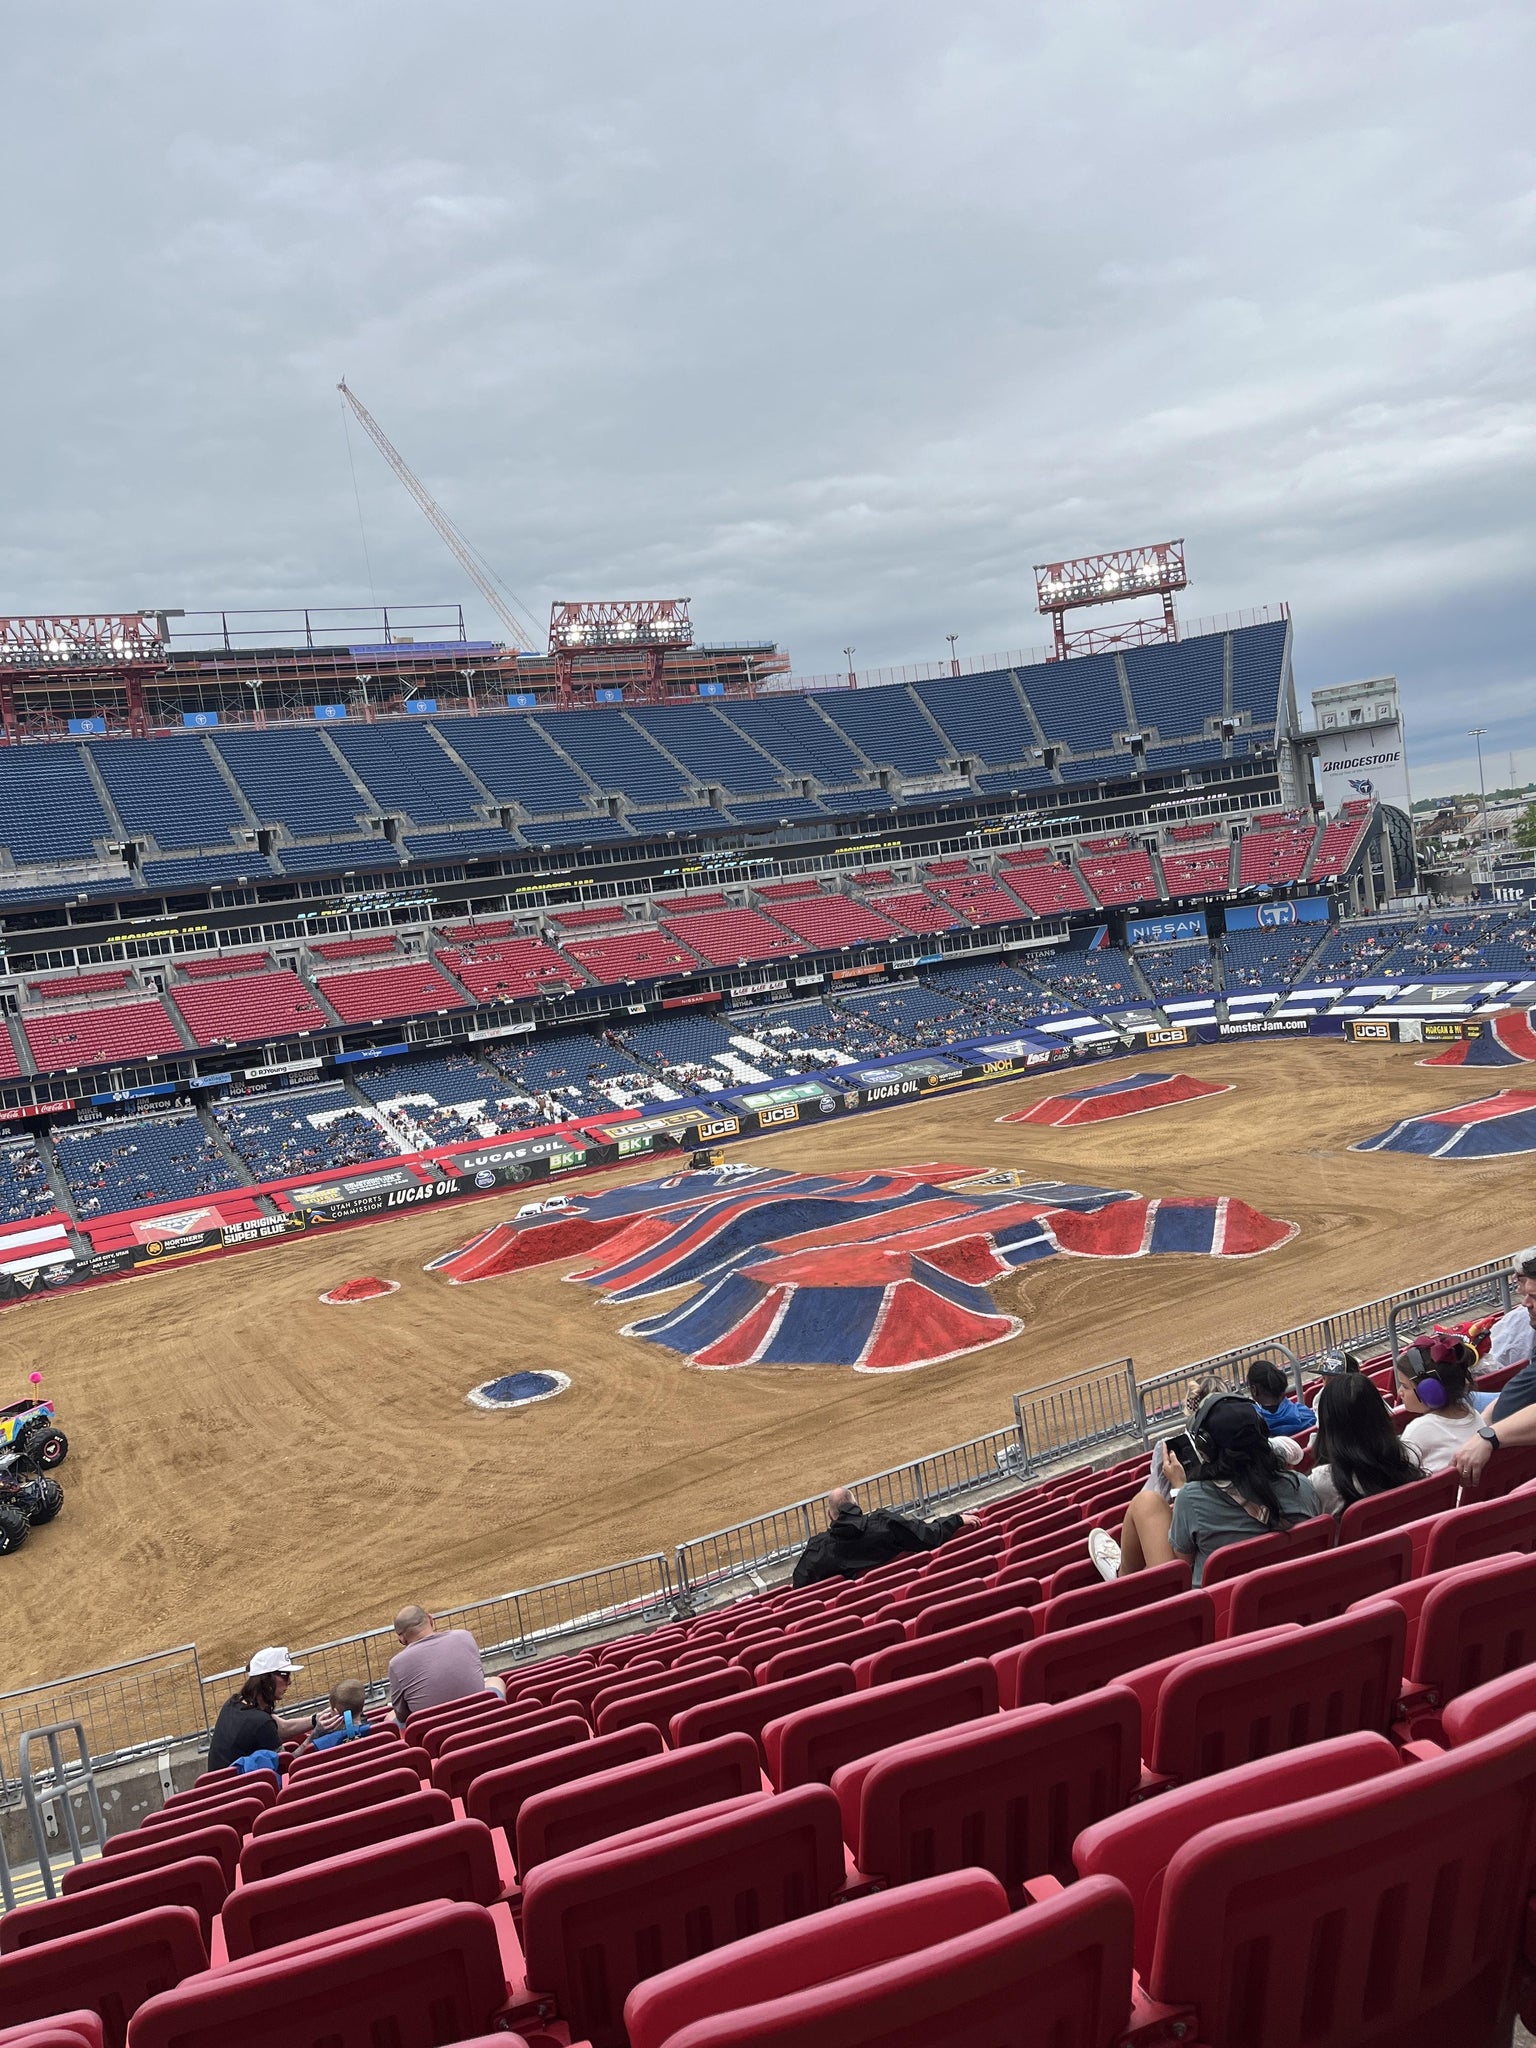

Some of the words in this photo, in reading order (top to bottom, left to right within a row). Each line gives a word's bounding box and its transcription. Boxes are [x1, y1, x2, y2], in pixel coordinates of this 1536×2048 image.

[1323, 751, 1400, 772] BRIDGESTONE
[1133, 920, 1200, 937] NISSAN
[1025, 949, 1056, 959] TITANS
[1220, 1020, 1307, 1035] MonsterJam.com
[1356, 1026, 1388, 1037] JCB
[1425, 1025, 1448, 1034] MORGAN
[1150, 1029, 1184, 1043] JCB
[1053, 1053, 1070, 1062] CARS
[288, 1069, 318, 1079] GEORGE
[983, 1059, 1013, 1074] UNOH
[289, 1075, 319, 1085] BLANDA
[745, 1084, 819, 1107] BKT
[867, 1084, 900, 1101] LUCAS
[137, 1097, 150, 1105] JIM
[137, 1100, 171, 1111] NORTON
[76, 1106, 98, 1116] MIKE
[77, 1112, 103, 1122] KEITH
[763, 1106, 796, 1123] JCB
[613, 1120, 667, 1136] JCB
[702, 1119, 737, 1137] JCB
[620, 1136, 652, 1151] BKT
[464, 1149, 527, 1168] LUCAS
[550, 1151, 586, 1167] BKT
[387, 1183, 433, 1206] LUCAS
[330, 1202, 351, 1212] UTAH
[353, 1196, 382, 1207] SPORTS
[332, 1202, 383, 1219] COMMISSION
[223, 1222, 242, 1234] THE
[244, 1213, 289, 1230] ORIGINAL
[164, 1233, 205, 1247] NORTHERN
[224, 1230, 257, 1244] SUPER
[260, 1223, 285, 1237] GLUE
[76, 1259, 89, 1267] SALT
[89, 1256, 102, 1264] LAKE
